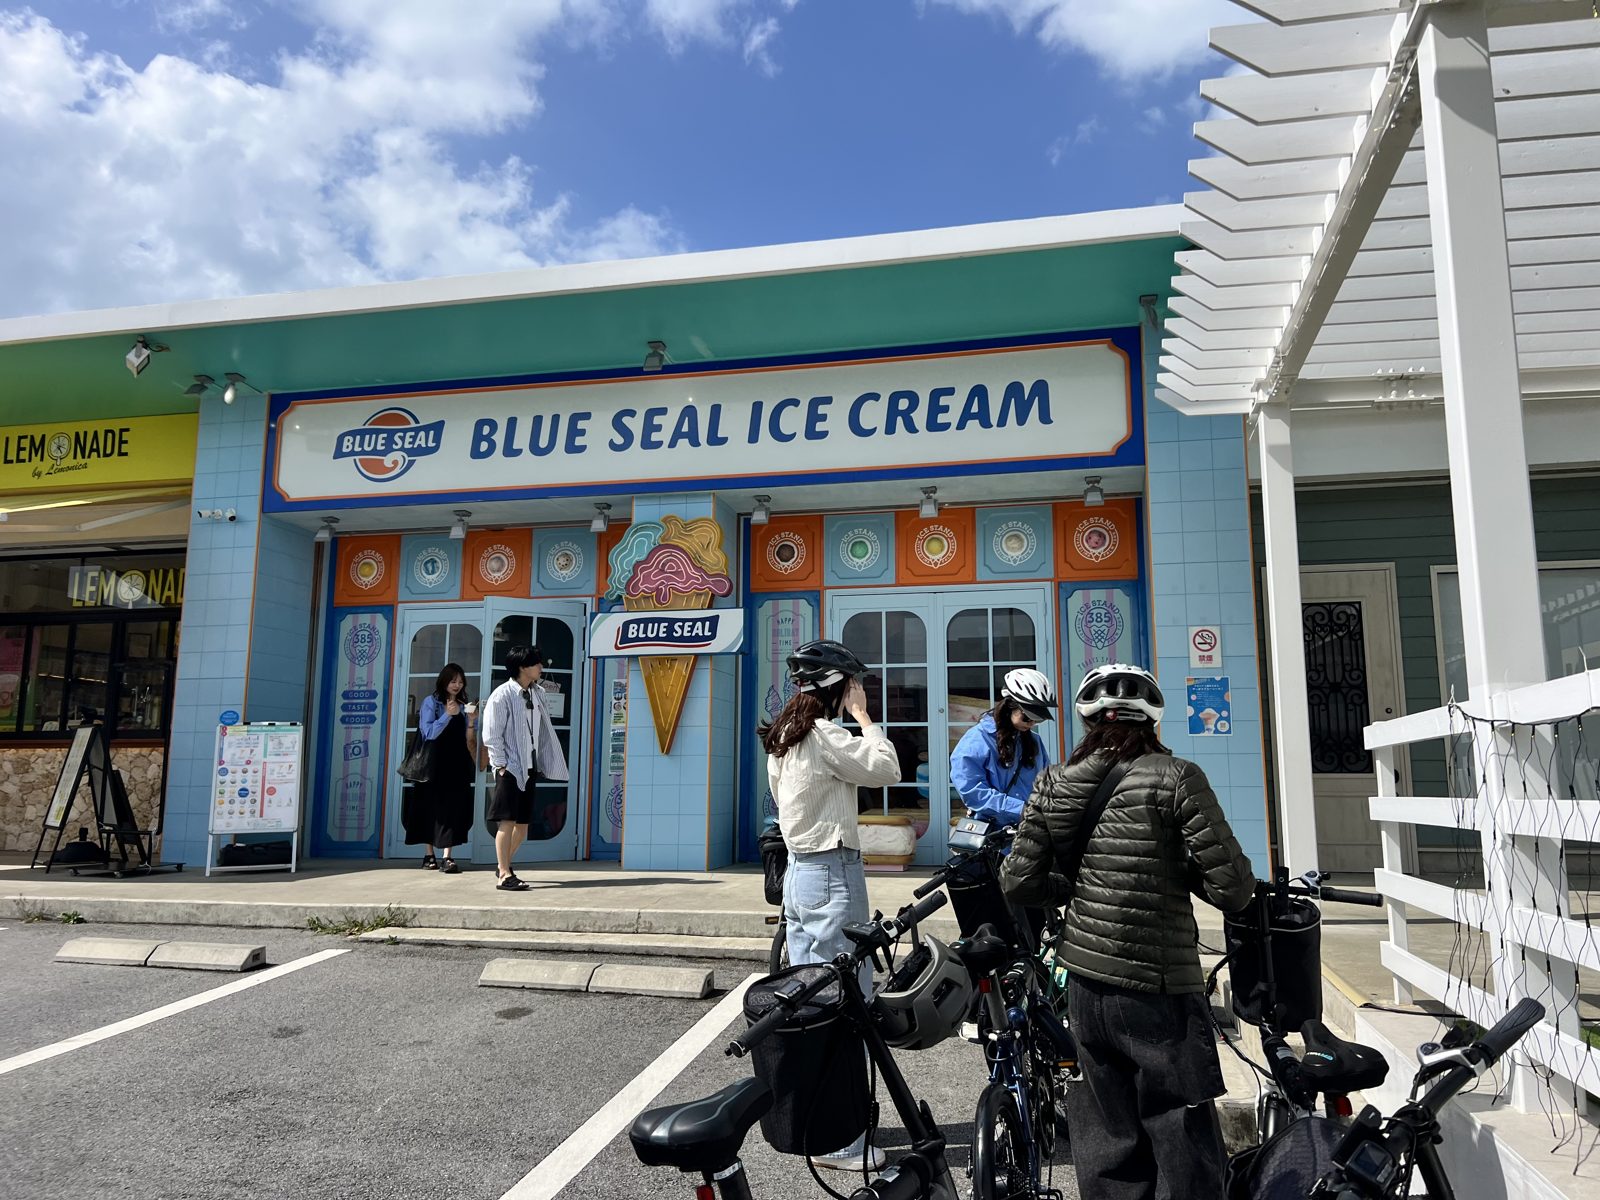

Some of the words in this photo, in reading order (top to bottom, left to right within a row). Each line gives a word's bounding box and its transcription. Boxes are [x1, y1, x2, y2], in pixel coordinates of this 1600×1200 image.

[470, 412, 592, 460] BLUE
[608, 403, 729, 452] SEAL
[747, 396, 833, 444] ICE
[848, 379, 1053, 437] CREAM
[342, 433, 386, 452] BLUE
[392, 430, 437, 449] SEAL
[31, 466, 42, 479] by
[45, 462, 88, 476] Lemonica
[995, 523, 1009, 536] ICE
[1008, 521, 1033, 534] STAND
[1075, 519, 1089, 532] ICE
[1089, 516, 1116, 530] STAND
[769, 533, 781, 546] ICE
[781, 531, 804, 545] STAND
[841, 530, 853, 542] ICE
[854, 528, 878, 541] STAND
[917, 527, 930, 540] ICE
[929, 525, 954, 538] STAND
[1077, 602, 1091, 616] ICE
[1091, 599, 1120, 615] STAND
[1088, 612, 1111, 623] 385
[359, 623, 379, 635] STAND
[627, 622, 668, 638] BLUE
[673, 621, 713, 637] SEAL
[354, 634, 372, 643] 385
